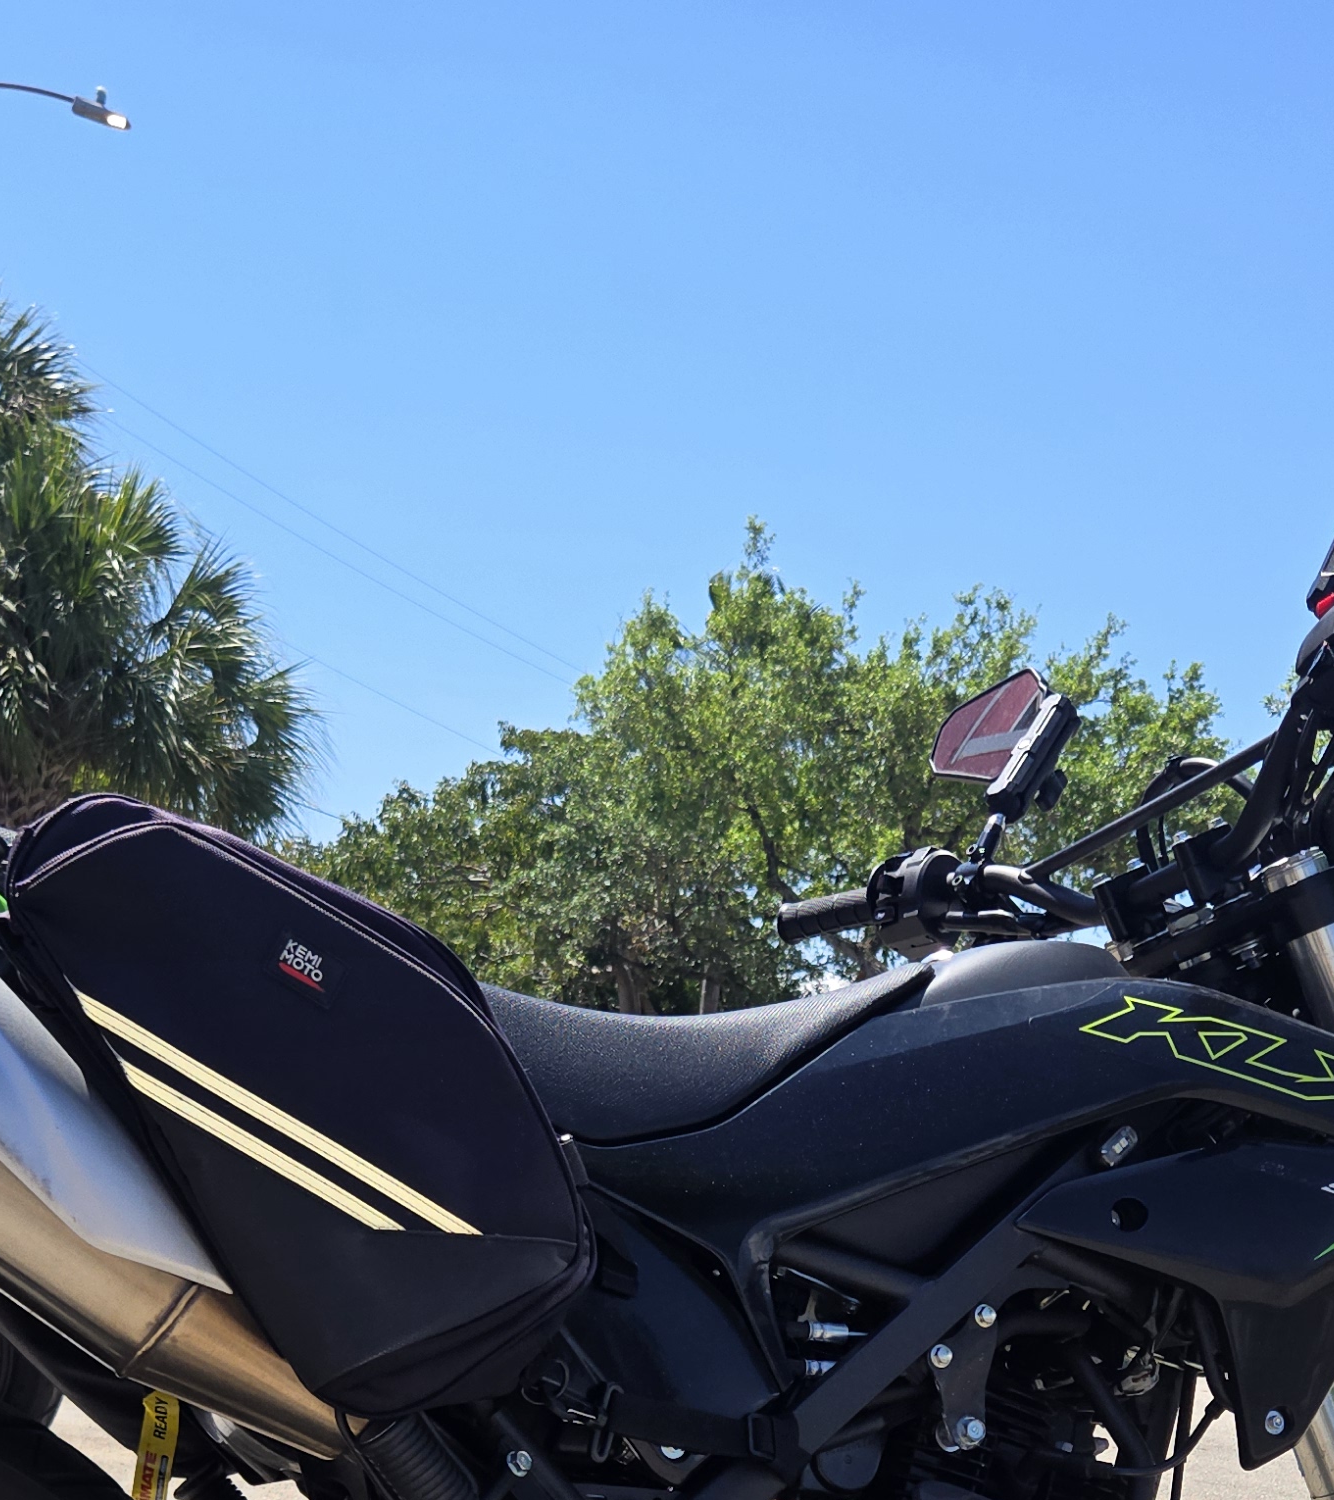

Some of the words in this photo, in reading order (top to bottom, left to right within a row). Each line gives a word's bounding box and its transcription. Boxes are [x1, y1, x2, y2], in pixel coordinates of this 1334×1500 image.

[279, 949, 323, 982] MOTO
[285, 939, 323, 968] KEMI
[152, 1397, 169, 1440] READY
